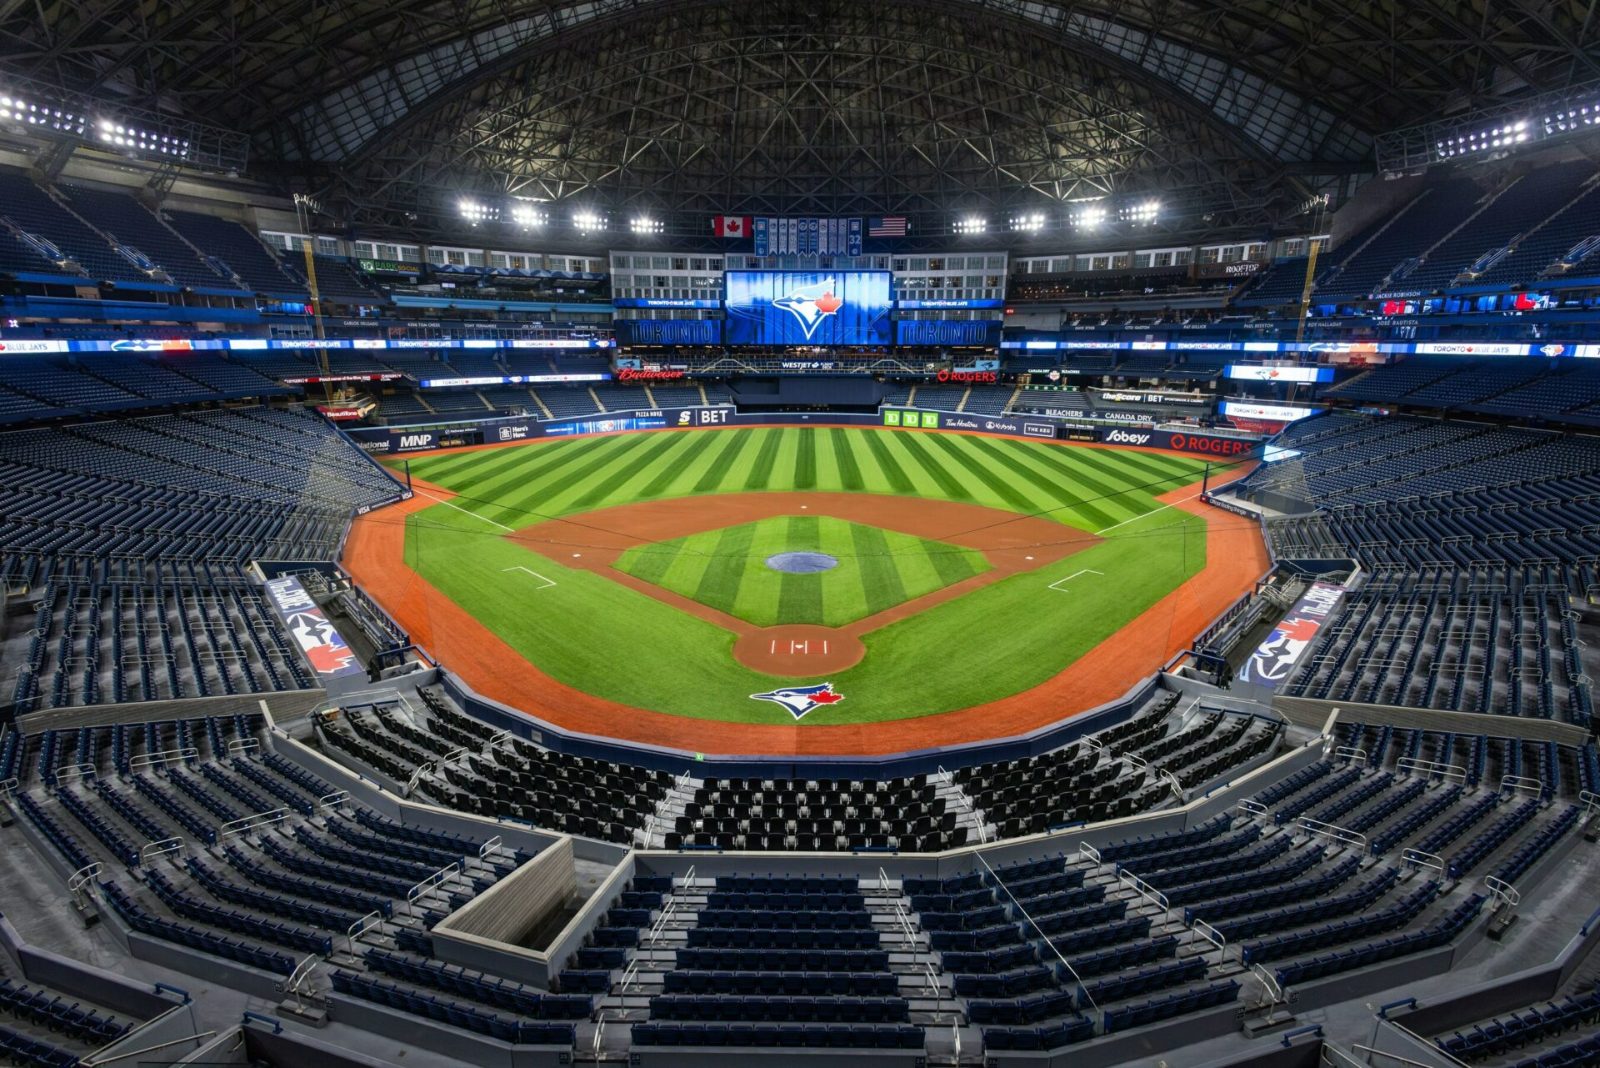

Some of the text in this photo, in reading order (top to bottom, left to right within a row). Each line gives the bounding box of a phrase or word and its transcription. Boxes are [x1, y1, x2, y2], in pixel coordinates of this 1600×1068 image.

[849, 235, 861, 244] 32
[1226, 264, 1259, 273] ROOFTOP
[630, 321, 713, 343] TORONTO
[904, 321, 987, 345] TORONTO
[782, 362, 811, 370] WESTJET
[618, 368, 684, 379] Budweiser
[950, 371, 997, 382] ROGERS
[1102, 393, 1142, 402] theScore
[1046, 409, 1083, 418] BLEACHERS
[1233, 407, 1257, 415] TORONTO
[701, 410, 728, 423] BET
[886, 413, 899, 423] TD
[905, 414, 918, 424] TD
[924, 415, 936, 425] TD
[1105, 412, 1153, 422] CANADA DRY
[945, 418, 978, 428] Tim Hortons
[400, 434, 432, 447] MNP
[1106, 429, 1150, 445] Sobeys
[1188, 437, 1252, 454] ROGERS
[357, 506, 370, 515] VISA
